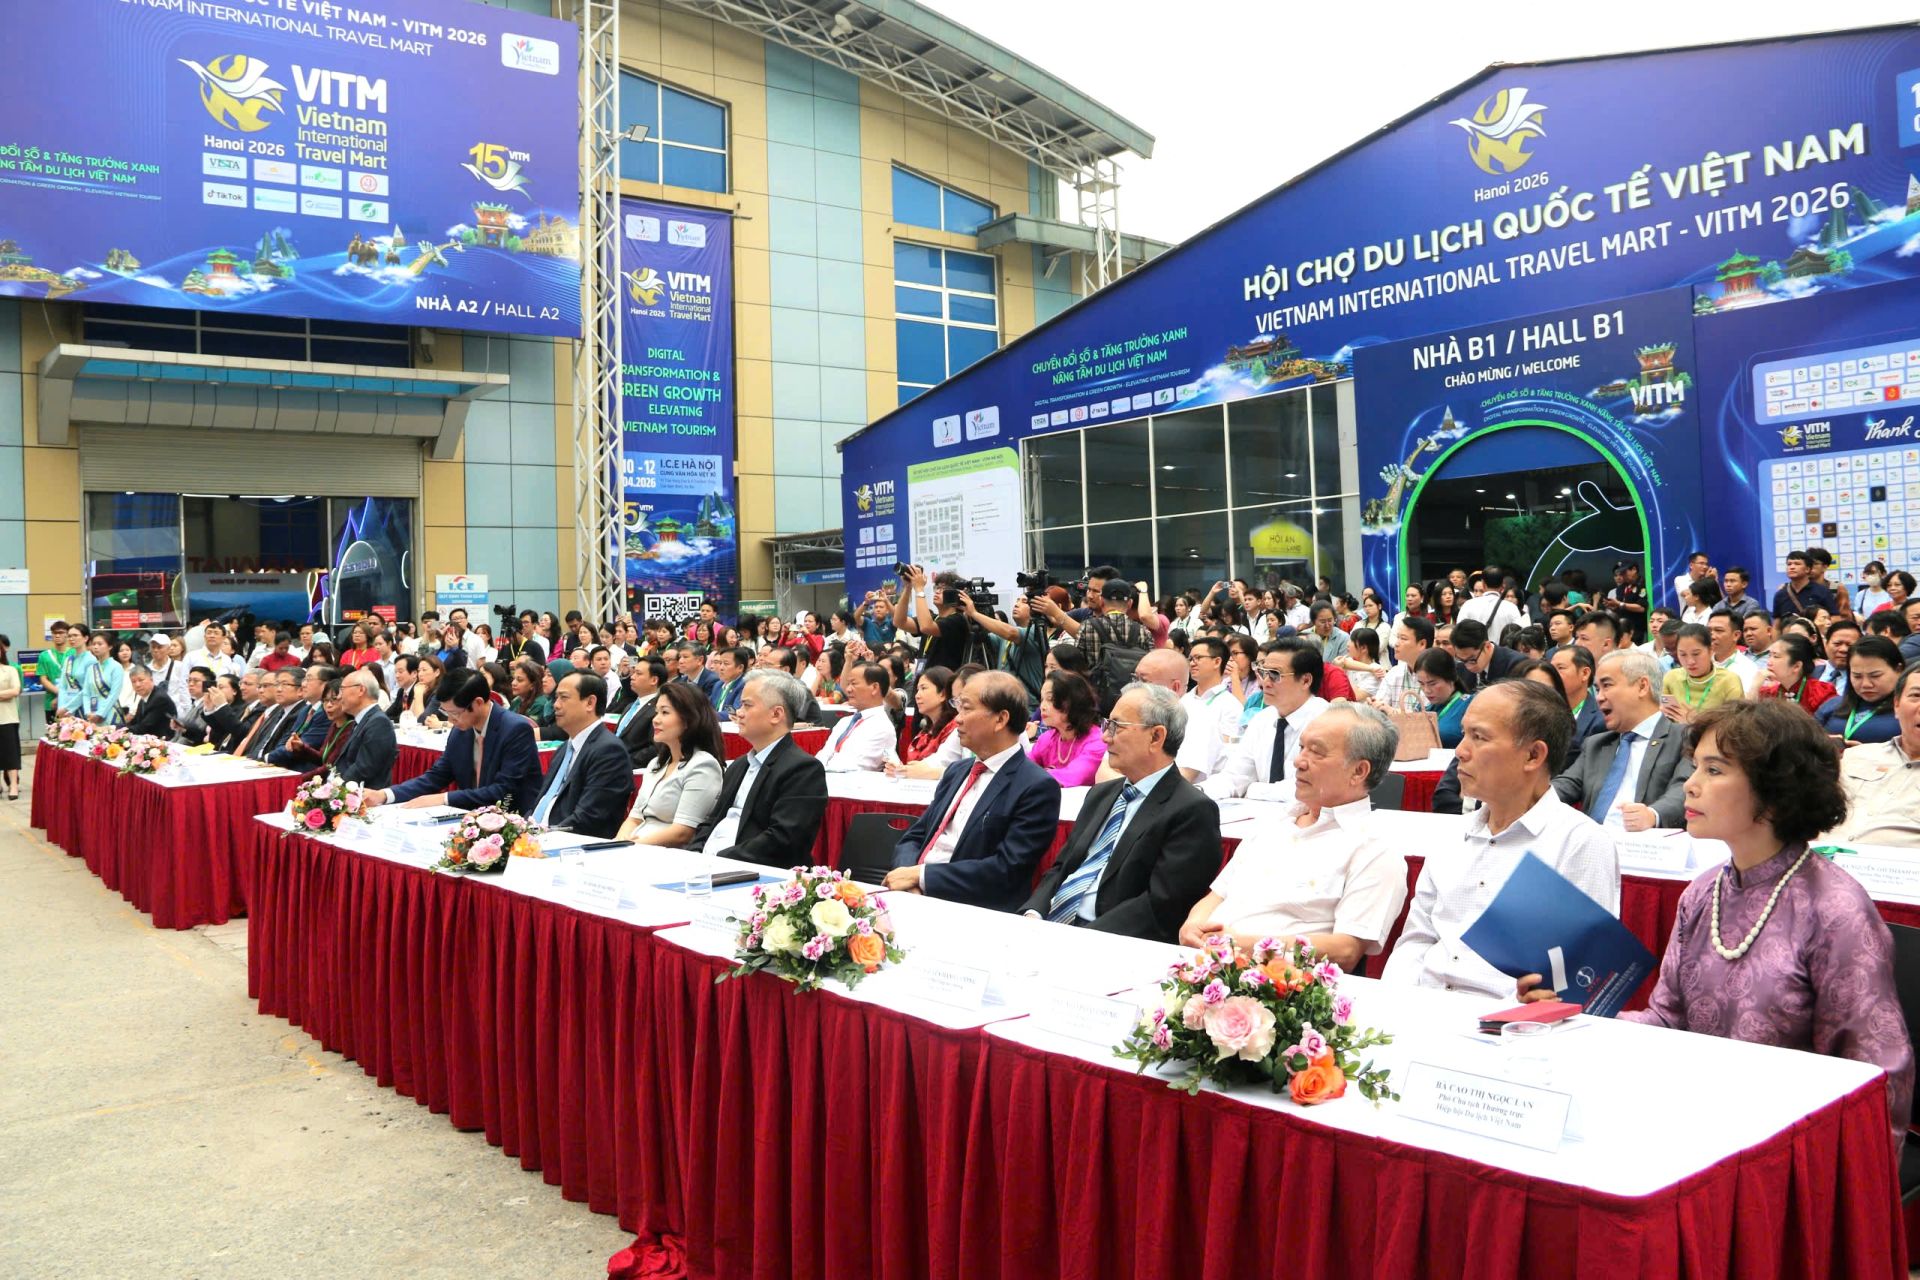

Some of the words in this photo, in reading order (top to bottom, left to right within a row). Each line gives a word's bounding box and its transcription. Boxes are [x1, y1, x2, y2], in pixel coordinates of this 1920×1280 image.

[187, 0, 322, 37] INTERNATIONAL
[326, 25, 388, 48] TRAVEL
[390, 38, 434, 57] MART
[303, 0, 342, 20] VIỆT
[347, 9, 387, 28] NAM
[402, 18, 443, 38] VITM
[447, 28, 487, 46] 2026
[291, 64, 388, 113] VITM
[296, 104, 388, 137] Vietnam
[203, 134, 245, 151] Hanoi
[248, 140, 286, 157] 2026
[298, 126, 388, 153] International
[24, 146, 40, 160] SỐ
[43, 152, 51, 161] &
[54, 152, 83, 165] TĂNG
[85, 155, 129, 170] TRƯỞNG
[131, 163, 160, 174] XANH
[294, 142, 346, 165] Travel
[350, 150, 388, 170] Mart
[469, 142, 507, 180] 15
[508, 150, 530, 162] VITM
[19, 158, 43, 173] TẦM
[45, 165, 60, 175] DU
[64, 167, 85, 179] LỊCH
[88, 168, 110, 182] VIỆT
[112, 173, 137, 184] NAM
[216, 191, 243, 201] TikTok
[1474, 181, 1511, 202] Hanoi
[1513, 172, 1550, 193] 2026
[1243, 264, 1289, 301] HỘI
[1296, 247, 1356, 284] CHỢ
[1363, 238, 1405, 272] DU
[1413, 219, 1484, 263] LỊCH
[1493, 185, 1595, 240] QUỐC
[1604, 163, 1652, 214] TẾ
[1660, 151, 1751, 199] VIỆT
[1763, 122, 1865, 176] NAM
[1255, 297, 1334, 334] VIETNAM
[1339, 262, 1501, 316] INTERNATIONAL
[1505, 240, 1596, 280] TRAVEL
[1601, 221, 1672, 260] MART
[1694, 200, 1763, 238] VITM
[1771, 182, 1850, 223] 2026
[667, 271, 711, 293] VITM
[416, 294, 452, 312] NHÀ
[456, 301, 478, 314] A2
[481, 300, 491, 316] /
[495, 303, 535, 318] HALL
[539, 307, 560, 320] A2
[670, 291, 711, 305] Vietnam
[670, 302, 711, 313] International
[630, 307, 648, 315] Hanoi
[649, 309, 666, 318] 2026
[669, 310, 693, 320] Travel
[693, 312, 711, 322] Mart
[1032, 353, 1061, 374] CHUYỂN
[1063, 349, 1077, 367] ĐỔI
[1079, 346, 1090, 364] SỐ
[1093, 350, 1098, 360] &
[1101, 343, 1122, 358] TĂNG
[1125, 333, 1160, 353] TRƯỞNG
[1162, 327, 1188, 343] XANH
[1413, 335, 1462, 370] NHÀ
[1468, 334, 1495, 361] B1
[1506, 330, 1516, 354] /
[1522, 318, 1587, 351] HALL
[1593, 310, 1624, 339] B1
[648, 347, 685, 361] DIGITAL
[1052, 370, 1074, 385] NÂNG
[1076, 364, 1093, 378] TẦM
[1095, 364, 1106, 374] DU
[1109, 359, 1125, 374] LỊCH
[1127, 353, 1145, 369] VIỆT
[1147, 349, 1167, 364] NAM
[620, 364, 710, 381] RANSFORMATION
[713, 371, 721, 381] &
[1444, 371, 1475, 388] CHÀO
[1478, 366, 1512, 383] MỪNG
[1514, 364, 1520, 377] /
[1522, 355, 1580, 376] WELCOME
[663, 386, 721, 402] GROWTH
[1630, 380, 1685, 406] VITM
[649, 404, 703, 417] ELEVATING
[622, 421, 668, 434] VIETNAM
[671, 423, 716, 436] TOURISM
[1803, 421, 1830, 434] VITM
[1864, 416, 1914, 441] Thank
[644, 459, 656, 475] 12
[660, 459, 680, 469] I.C.E
[682, 457, 696, 469] HÀ
[698, 459, 716, 471] NỘI
[1624, 430, 1634, 441] DU
[1650, 467, 1662, 487] NAM
[873, 480, 894, 496] VITM
[1435, 1081, 1447, 1091] BÀ
[1449, 1084, 1468, 1096] CAO
[1470, 1088, 1485, 1101] THỊ
[1487, 1092, 1514, 1106] NGỌC
[1515, 1099, 1534, 1110] LAN
[1504, 1119, 1522, 1129] Nam
